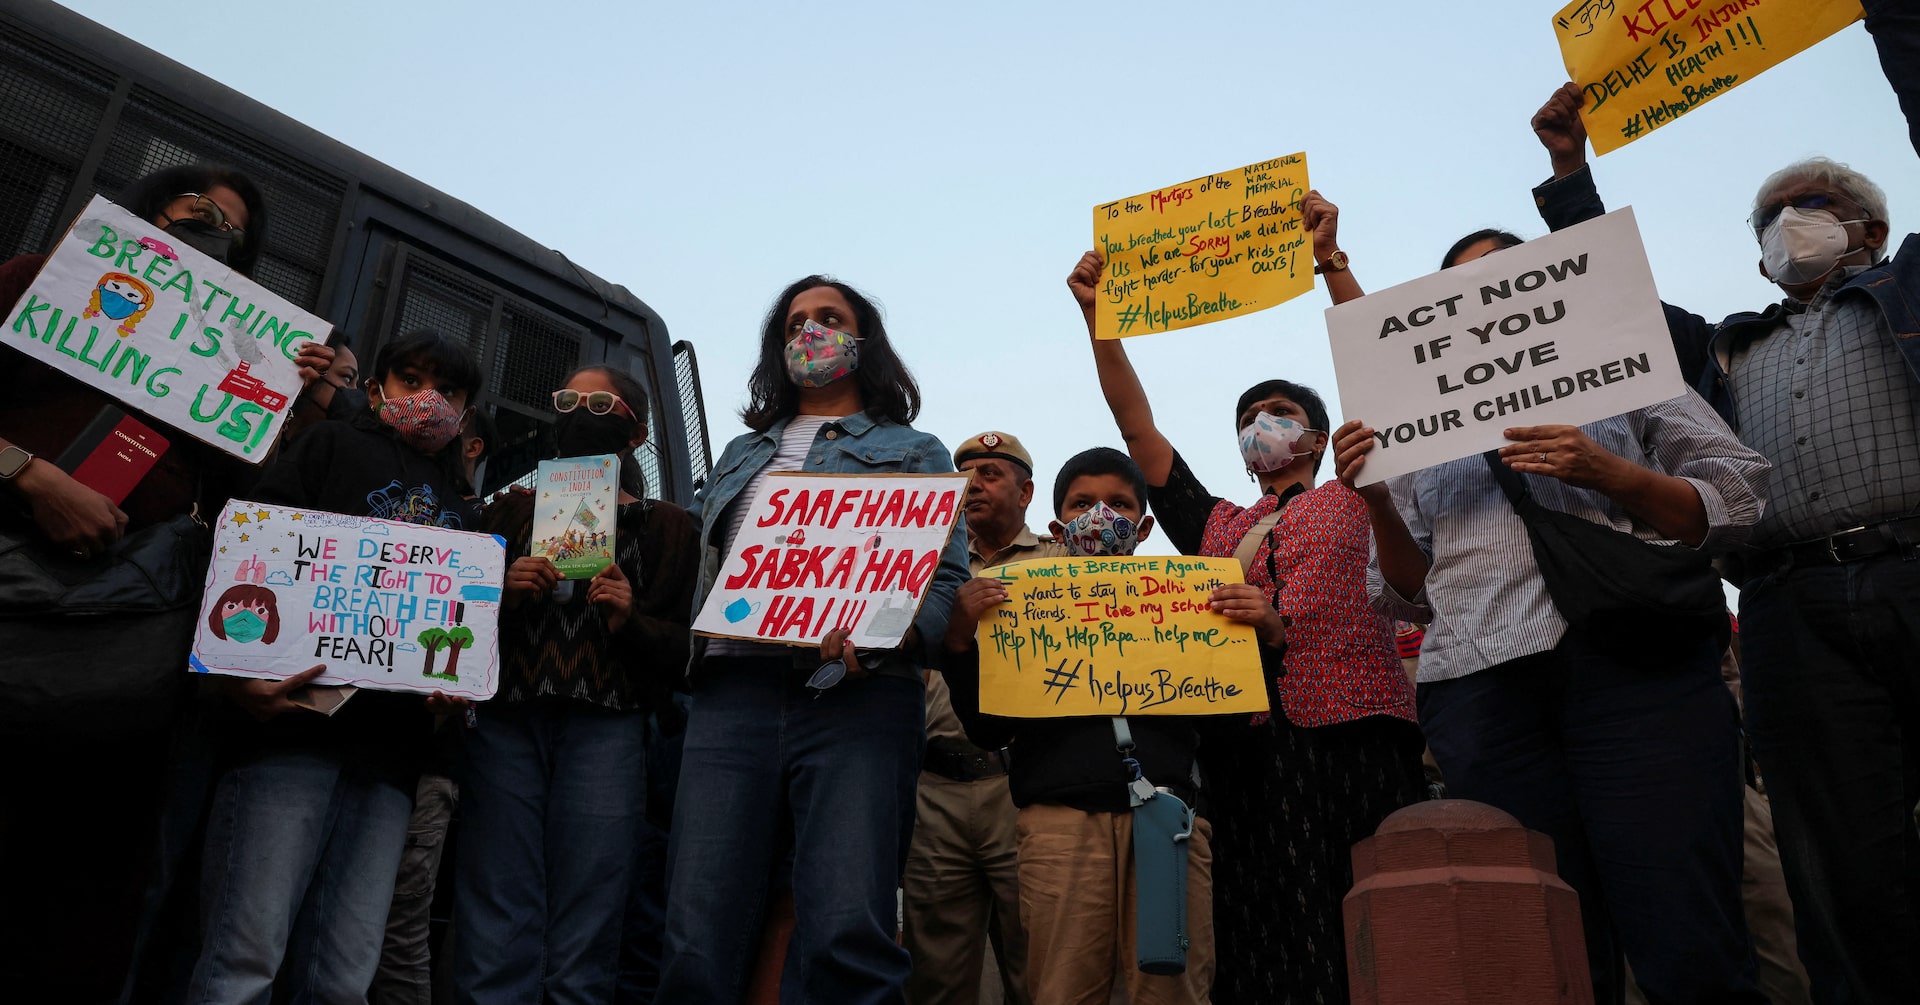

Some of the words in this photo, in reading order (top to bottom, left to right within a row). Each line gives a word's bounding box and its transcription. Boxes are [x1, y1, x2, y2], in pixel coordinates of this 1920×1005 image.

[1583, 47, 1657, 114] DELHI
[1621, 74, 1738, 138] #HelpusBreathe
[1245, 156, 1301, 176] NATIONAL
[1247, 174, 1271, 184] WAR
[1102, 203, 1119, 220] To
[1126, 202, 1143, 214] the
[1151, 188, 1193, 214] Martyrs
[1202, 177, 1215, 193] of
[1216, 178, 1232, 190] the
[1102, 235, 1124, 269] You
[1126, 228, 1176, 251] breathed
[1179, 221, 1205, 245] your
[1209, 209, 1239, 229] last
[1242, 202, 1286, 223] Breath
[1141, 248, 1160, 269] We
[1165, 248, 1182, 261] are
[1182, 236, 1230, 257] SORRY
[1237, 231, 1252, 242] we
[1103, 281, 1140, 304] fight
[1190, 257, 1206, 273] for
[1206, 254, 1243, 277] your
[1249, 245, 1274, 261] kids
[1280, 235, 1305, 253] and
[1253, 252, 1295, 279] ours!
[87, 225, 314, 361] BREATHING
[1379, 294, 1463, 339] ACT
[1479, 253, 1589, 306] NOW
[12, 295, 182, 398] KILLING
[169, 312, 224, 358] IS
[1413, 335, 1452, 365] IF
[1467, 300, 1567, 345] YOU
[1437, 341, 1559, 395] LOVE
[189, 383, 274, 454] US!
[1373, 409, 1464, 449] YOUR
[1473, 353, 1651, 422] CHILDREN
[115, 430, 157, 458] CONSTITUTION
[117, 451, 131, 463] INDIA
[549, 467, 604, 482] CONSTITUTION
[569, 481, 591, 492] INDIA
[297, 534, 338, 560] WE
[357, 538, 461, 569] DESERVE
[991, 563, 1020, 580] I
[1027, 564, 1063, 579] want
[1067, 563, 1082, 578] to
[1083, 560, 1159, 576] BREATHE
[294, 560, 347, 584] THE
[354, 564, 422, 592] RIGHT
[424, 571, 452, 595] TO
[1023, 582, 1063, 601] want
[1067, 582, 1081, 600] to
[1088, 581, 1117, 609] stay
[1126, 581, 1139, 597] in
[1140, 576, 1185, 597] Delhi
[309, 612, 414, 639] WITHOUT
[998, 608, 1018, 628] my
[1022, 602, 1071, 623] friends.
[1074, 602, 1100, 623] I
[1105, 603, 1135, 618] love
[1140, 603, 1164, 624] my
[1170, 598, 1212, 615] schoo
[315, 636, 394, 673] FEAR!
[990, 623, 1025, 672] Help
[1030, 624, 1061, 663] Ma,
[1066, 626, 1099, 657] Help
[1154, 624, 1191, 652] help
